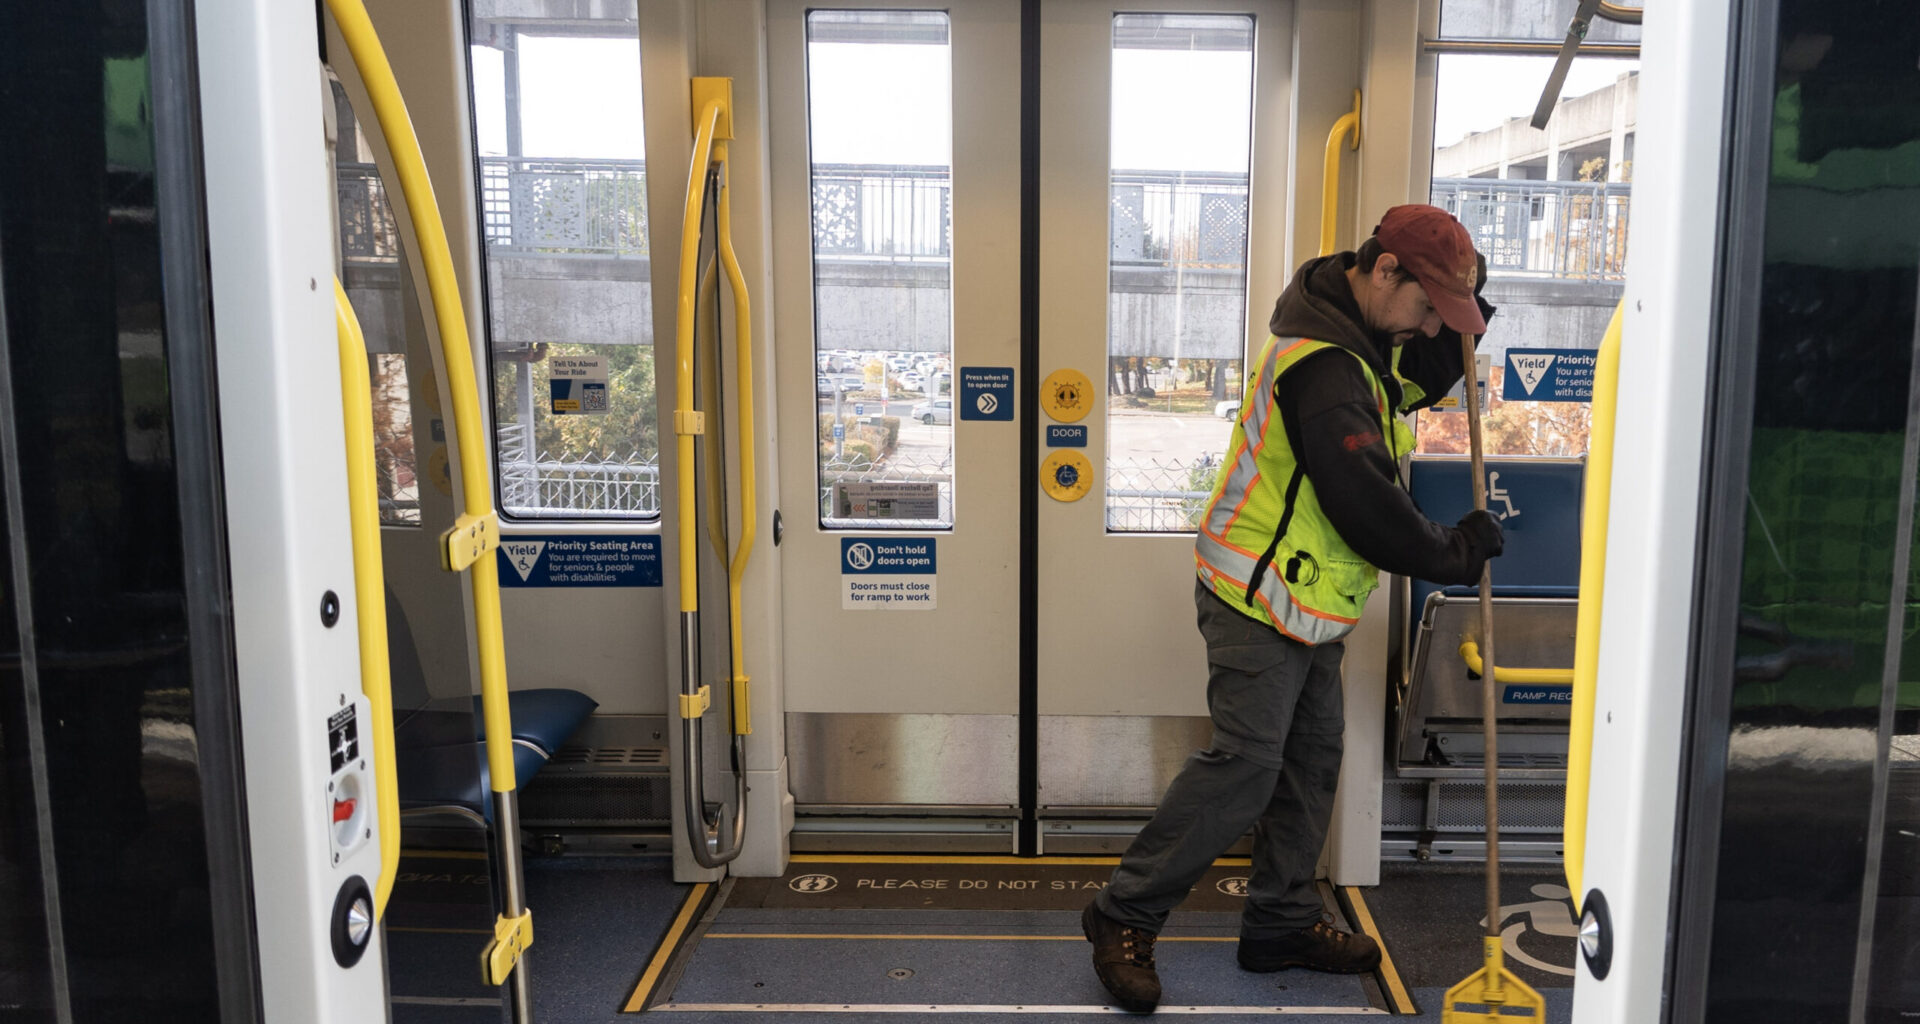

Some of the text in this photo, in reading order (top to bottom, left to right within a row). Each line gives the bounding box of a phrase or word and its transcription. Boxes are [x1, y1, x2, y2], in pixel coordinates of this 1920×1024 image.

[1517, 358, 1546, 369] Yield
[1557, 355, 1596, 366] Priority
[1556, 367, 1572, 376] You
[1573, 368, 1588, 376] are
[1555, 376, 1593, 386] for senio
[1554, 388, 1574, 396] with
[1052, 428, 1082, 437] DOOR
[508, 545, 537, 556] Yield
[548, 541, 654, 552] Priority Seating Area
[877, 545, 927, 554] Don't hold
[548, 553, 565, 561] You
[582, 552, 618, 563] required
[620, 553, 630, 561] to
[877, 557, 930, 566] doors open
[549, 563, 635, 573] for seniors & people
[549, 573, 617, 582] with disabilities
[850, 582, 930, 590] Doors must close
[851, 593, 930, 602] for ramp to work
[1512, 692, 1546, 700] RAMP
[856, 879, 950, 889] PLEASE
[959, 879, 988, 889] DO
[998, 880, 1040, 890] NOT
